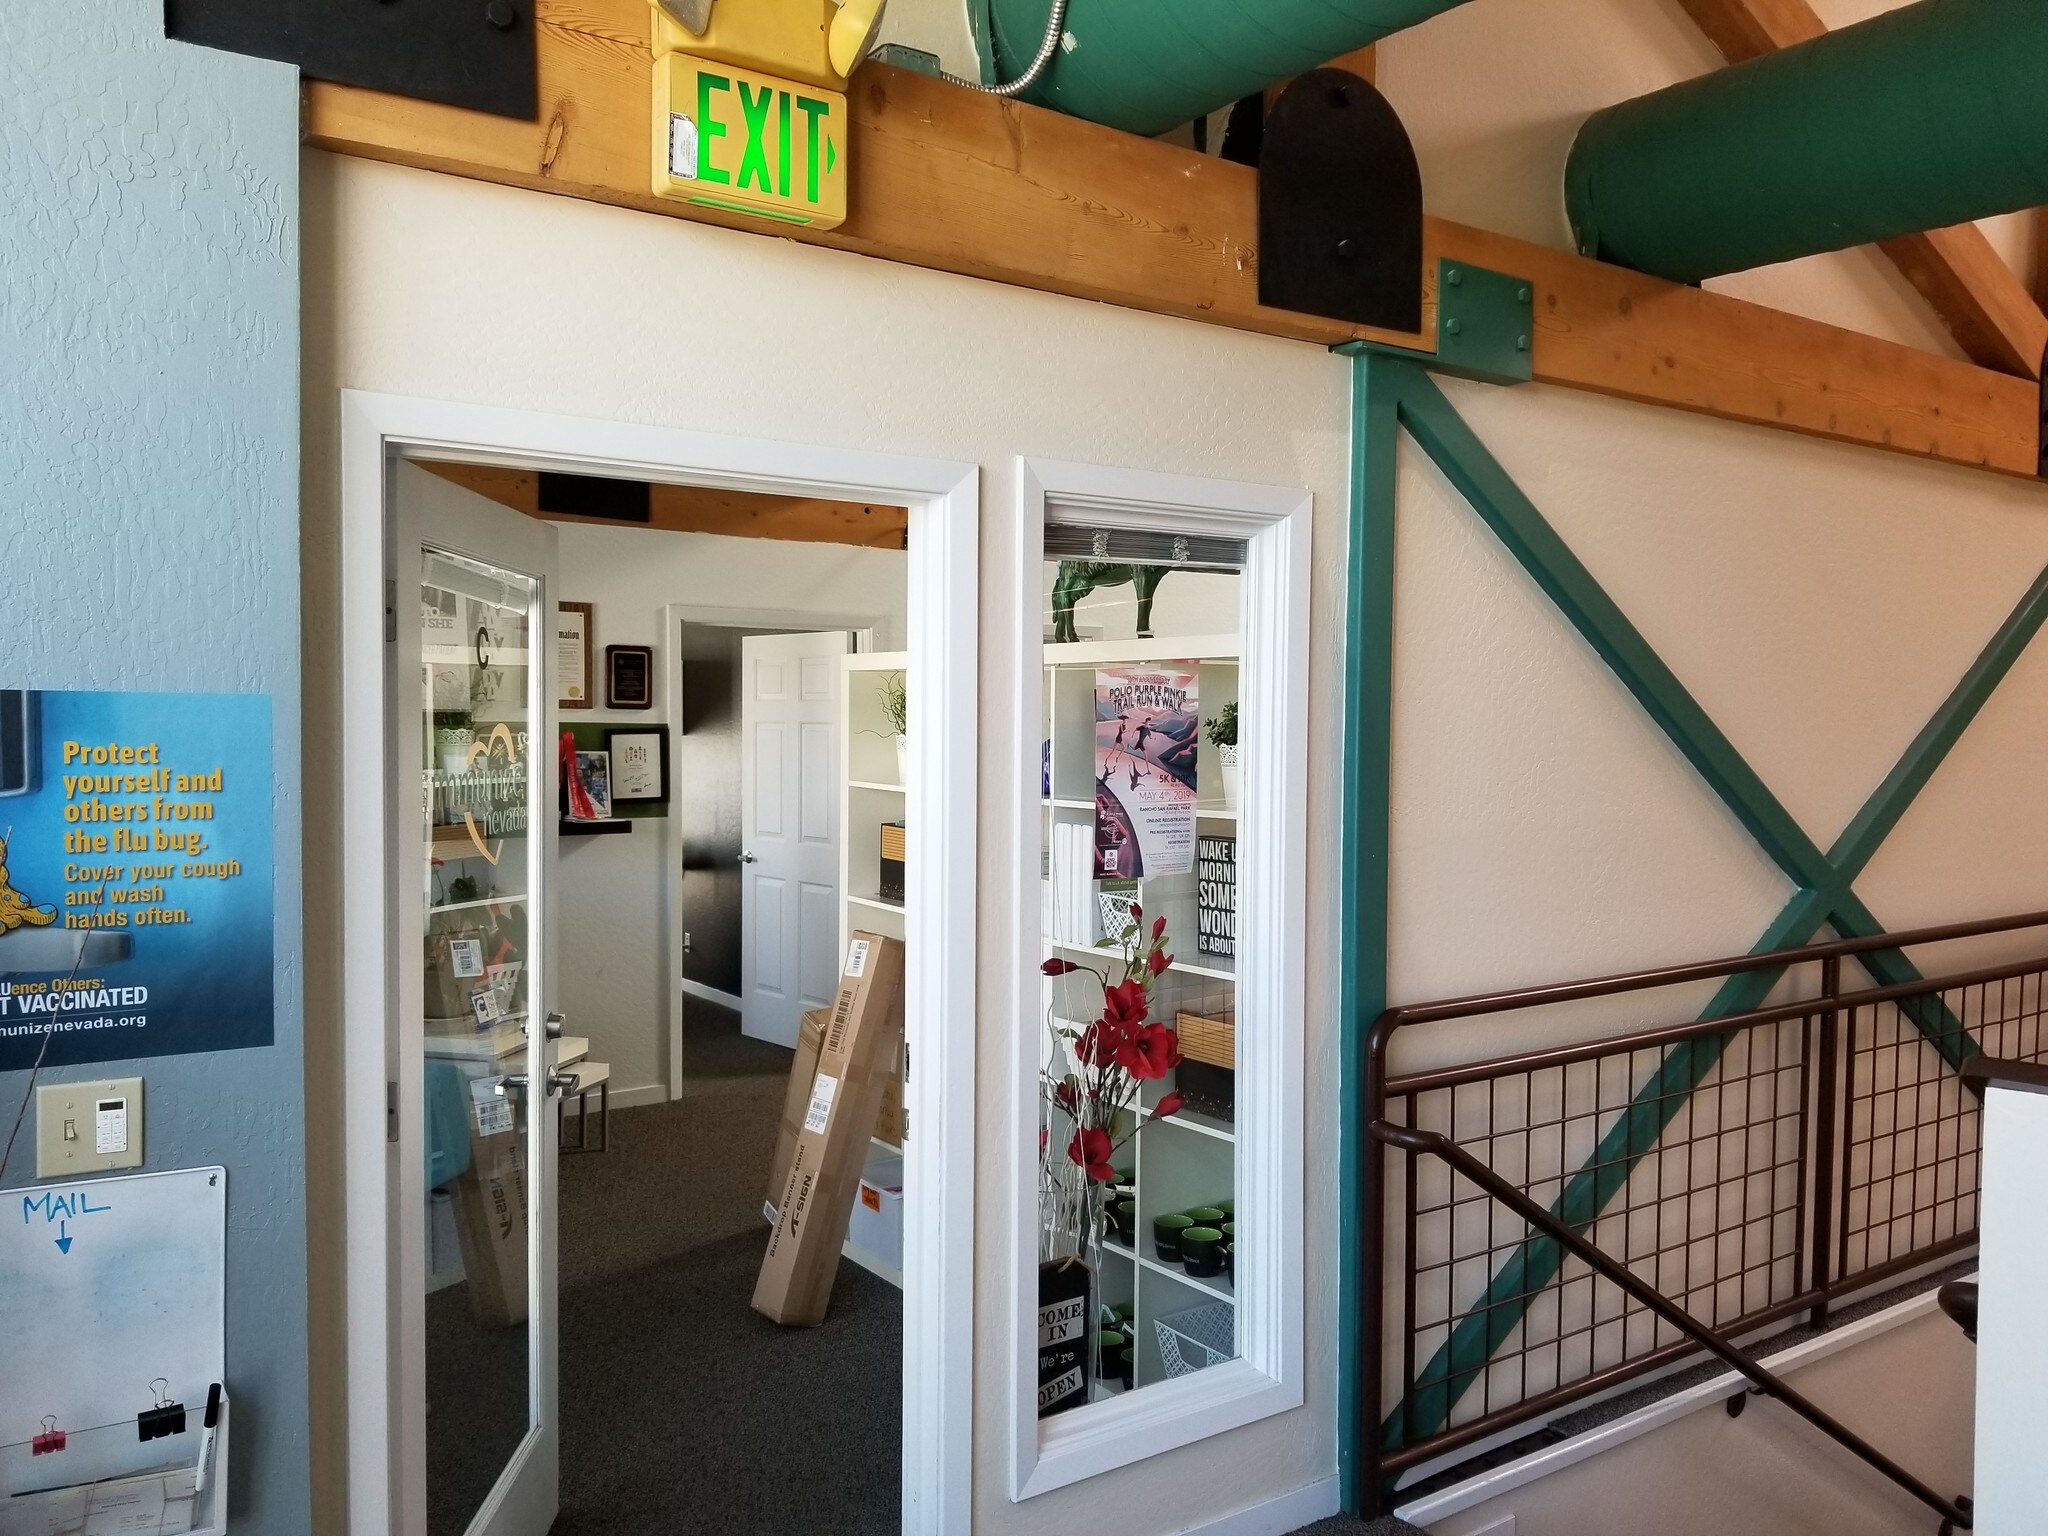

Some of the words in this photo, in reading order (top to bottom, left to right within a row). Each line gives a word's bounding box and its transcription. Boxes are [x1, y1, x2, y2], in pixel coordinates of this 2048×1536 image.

[697, 71, 829, 203] EXIT
[1109, 685, 1132, 701] POLIO
[1134, 684, 1161, 697] PURPLE
[1163, 686, 1187, 703] PINKIE
[1112, 697, 1134, 715] TRAIL
[1136, 694, 1152, 707] RUN
[1154, 696, 1160, 707] &
[1161, 697, 1183, 715] WALK
[63, 740, 159, 765] Protect
[62, 767, 171, 800] yourself
[175, 767, 222, 792] and
[1159, 774, 1169, 783] 5K
[1139, 791, 1156, 801] MAY
[1173, 790, 1191, 801] 2019
[64, 797, 148, 823] others
[153, 796, 213, 821] from
[483, 800, 527, 836] nevada
[64, 828, 107, 854] the
[112, 827, 147, 852] flu
[153, 827, 208, 856] bug.
[1199, 840, 1229, 862] WAKE
[64, 863, 124, 882] Cover
[130, 864, 175, 883] your
[181, 858, 240, 880] cough
[65, 886, 103, 906] and
[110, 884, 164, 904] wash
[65, 908, 129, 929] hands
[134, 906, 192, 926] often.
[1199, 934, 1208, 950] IS
[1209, 936, 1236, 955] ABOUT
[52, 979, 105, 993] Others:
[17, 986, 148, 1014] VACCINATED
[23, 1192, 111, 1224] MAIL
[769, 1210, 787, 1257] Backdrop
[783, 1173, 797, 1209] Banner
[795, 1144, 805, 1172] stand
[1038, 1302, 1081, 1328] COME
[1047, 1322, 1069, 1342] IN
[1040, 1351, 1075, 1371] We're
[1038, 1372, 1077, 1406] OPEN
